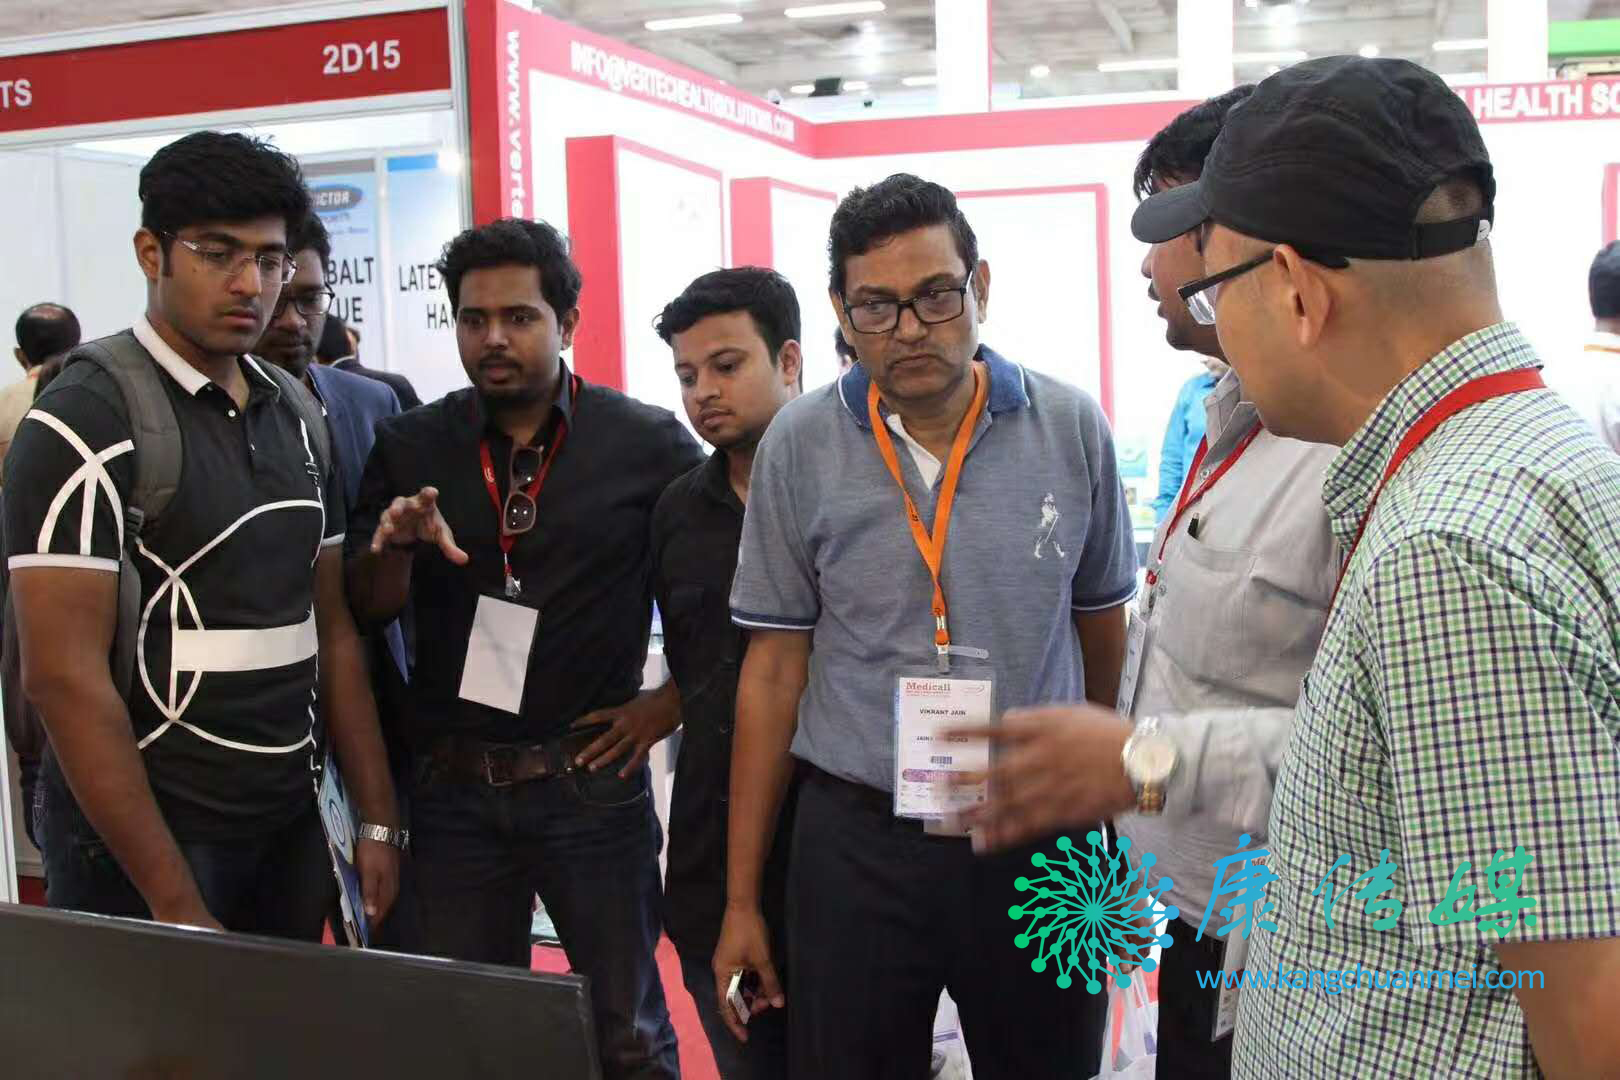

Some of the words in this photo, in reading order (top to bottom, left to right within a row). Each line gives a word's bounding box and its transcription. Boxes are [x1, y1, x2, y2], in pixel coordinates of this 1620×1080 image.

[323, 40, 401, 75] 2D15
[1472, 84, 1584, 119] HEALTH
[906, 682, 951, 692] Medicall
[919, 708, 949, 717] VIKRANT
